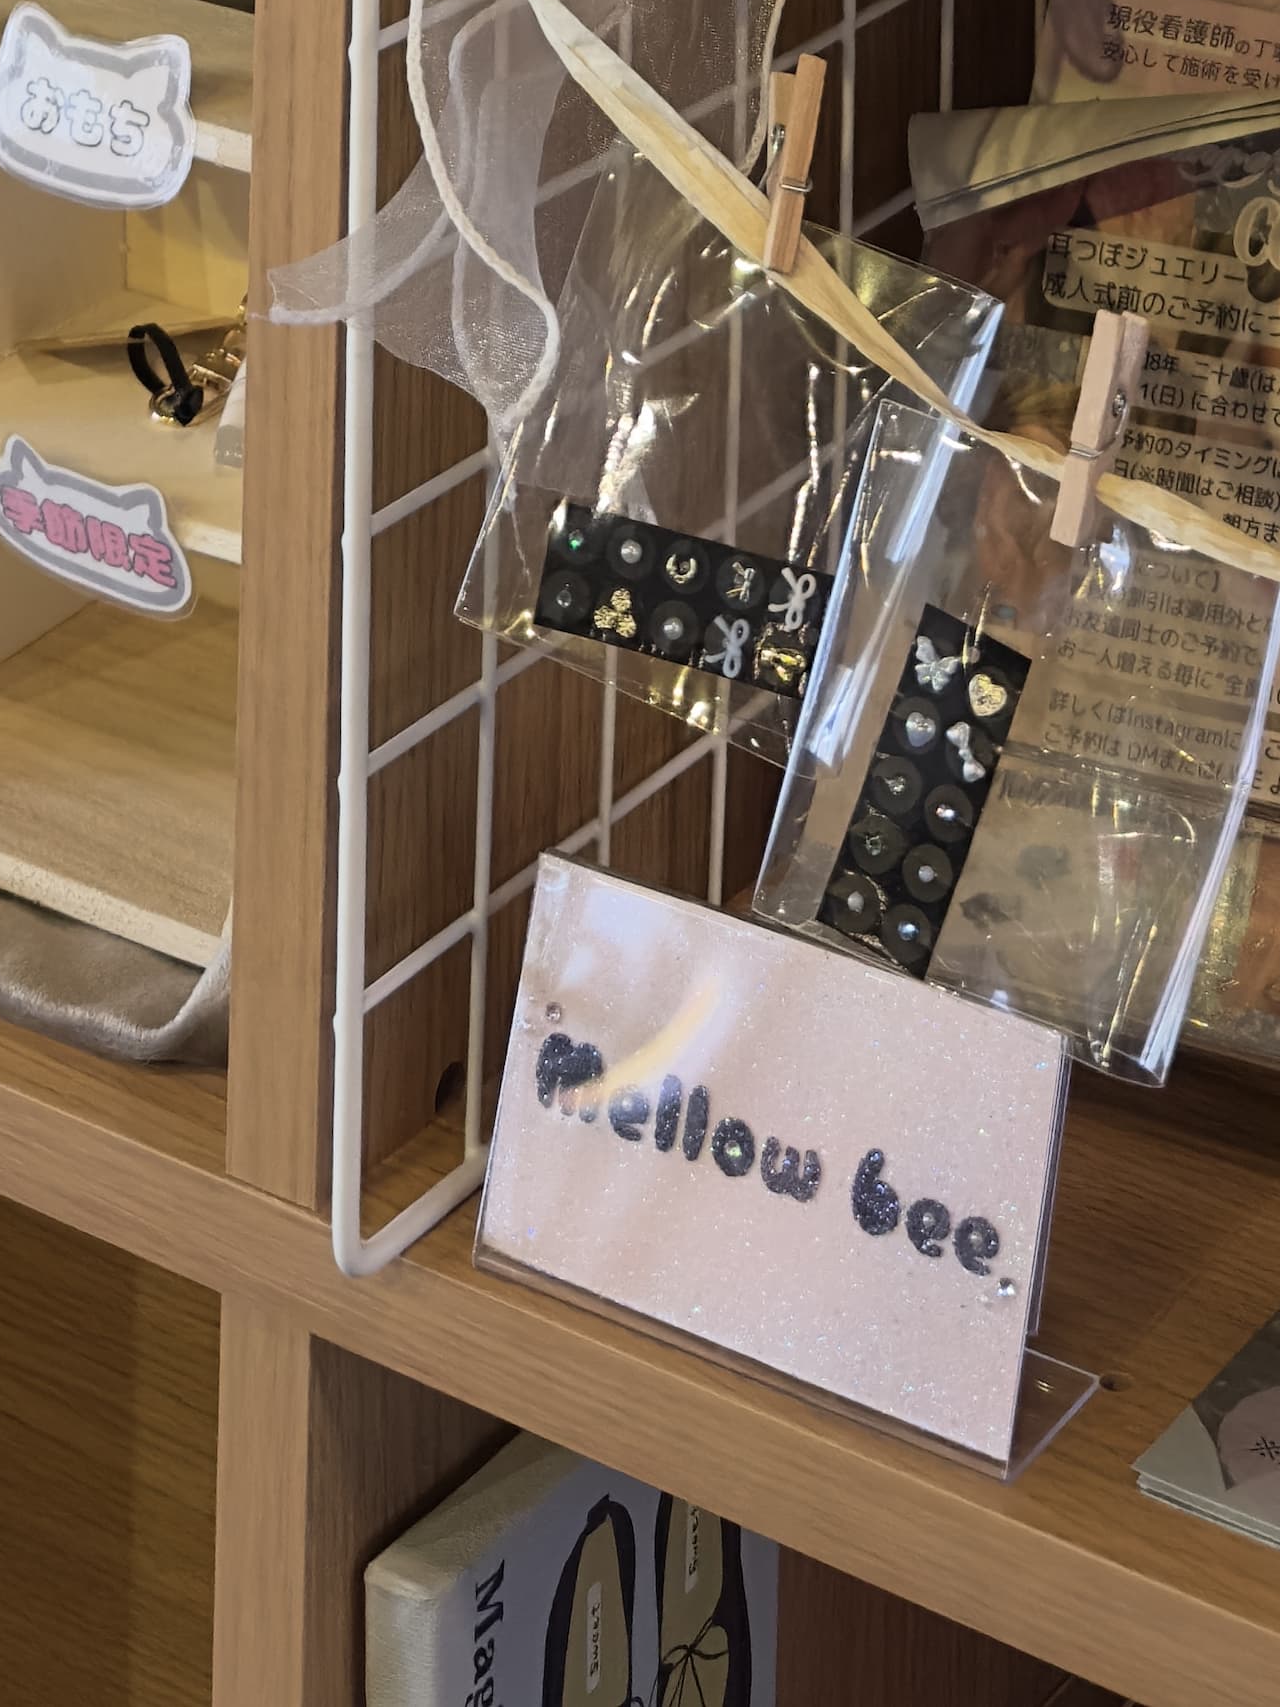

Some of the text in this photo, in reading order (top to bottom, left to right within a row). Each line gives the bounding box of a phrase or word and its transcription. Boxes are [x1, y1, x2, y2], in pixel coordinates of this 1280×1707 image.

[19, 75, 152, 158] おもち
[1048, 231, 1250, 288] 耳つぼジュエリー
[1, 486, 177, 590] 季節限定
[851, 1147, 1000, 1276] bee
